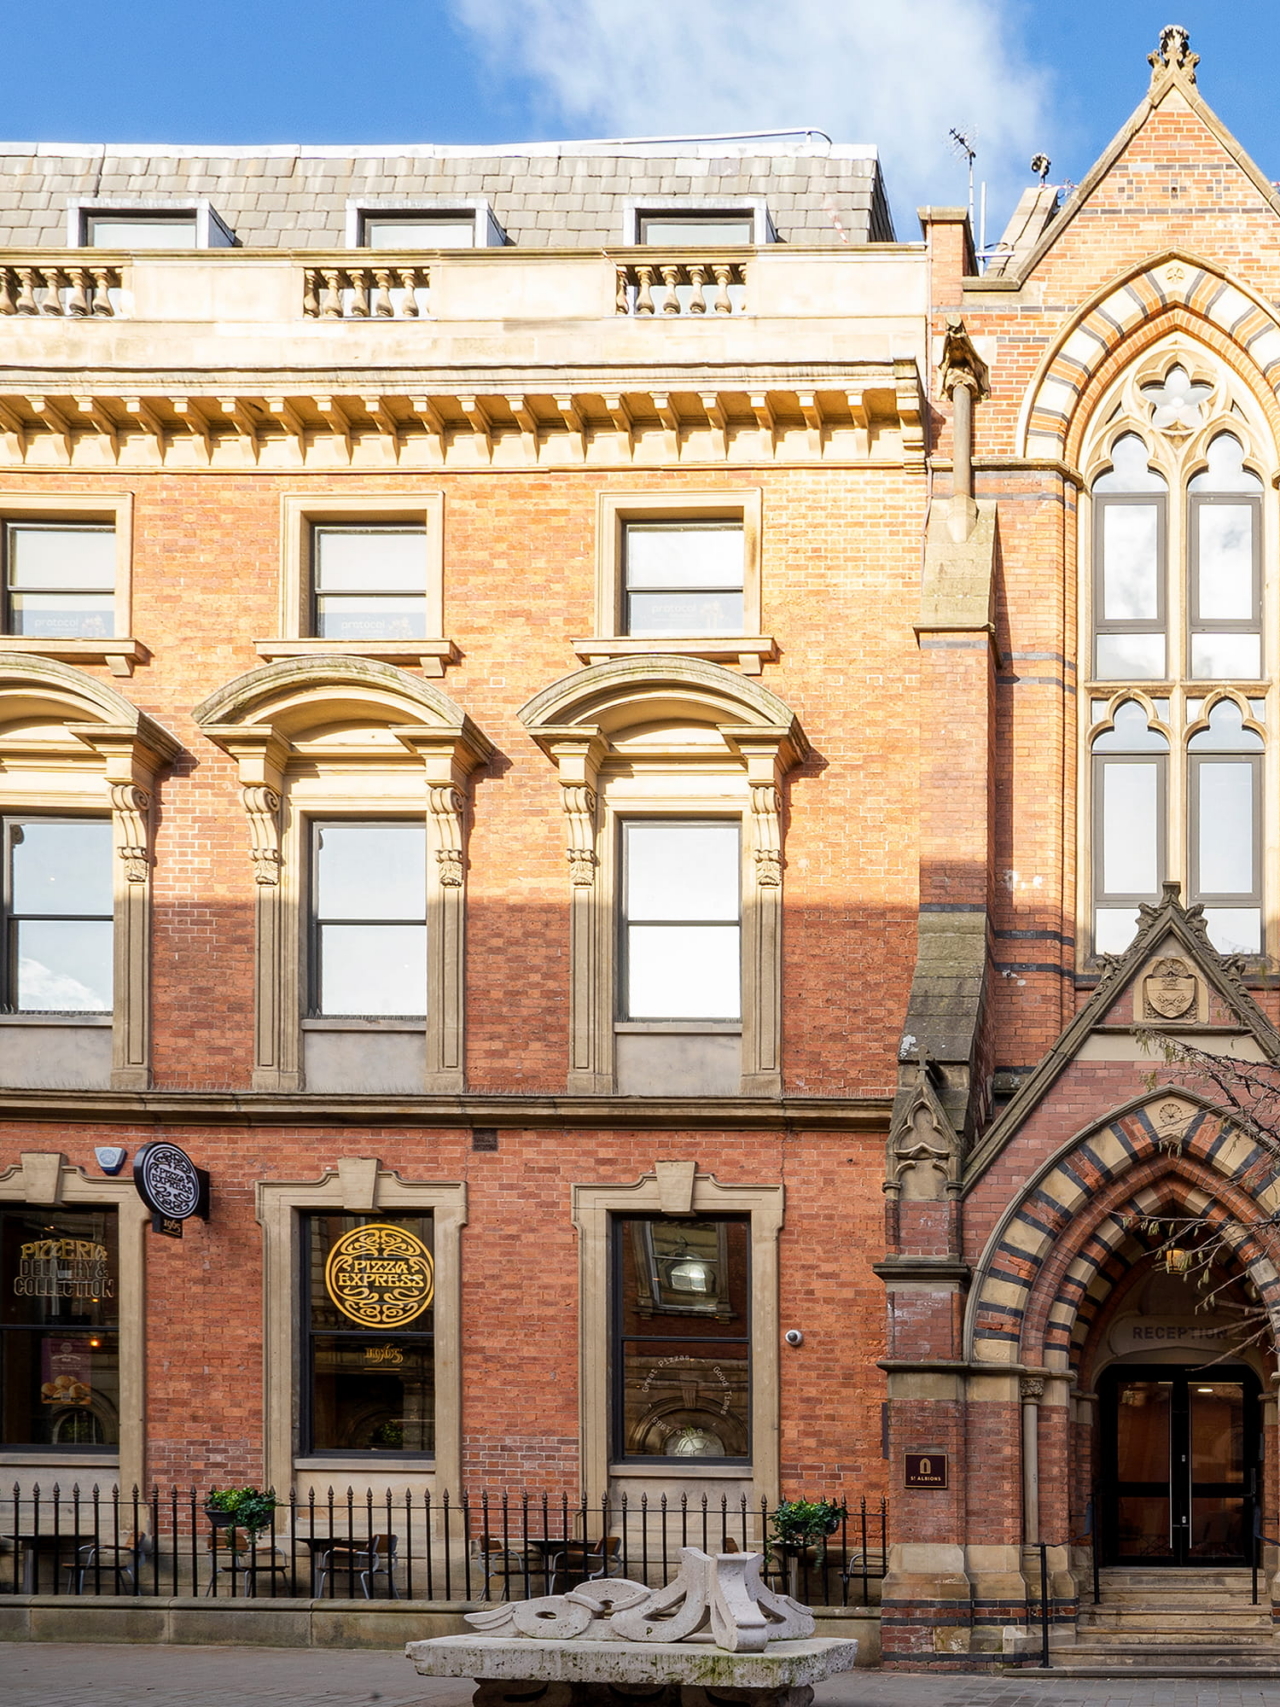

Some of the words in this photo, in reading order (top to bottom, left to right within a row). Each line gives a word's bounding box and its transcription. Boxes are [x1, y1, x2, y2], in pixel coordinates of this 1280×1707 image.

[34, 616, 79, 628] protocol
[151, 1173, 193, 1196] EXPRESS
[160, 1167, 186, 1184] PIZZA
[163, 1219, 181, 1233] 1965
[20, 1238, 108, 1260] PIZZERIA
[20, 1259, 93, 1279] DELIVERY
[94, 1260, 109, 1279] &
[353, 1260, 409, 1274] PIZZA
[13, 1276, 114, 1298] COLLECTION
[338, 1273, 425, 1288] EXPRESS
[364, 1343, 404, 1364] 1965
[641, 1368, 658, 1393] Great
[713, 1366, 730, 1387] Good
